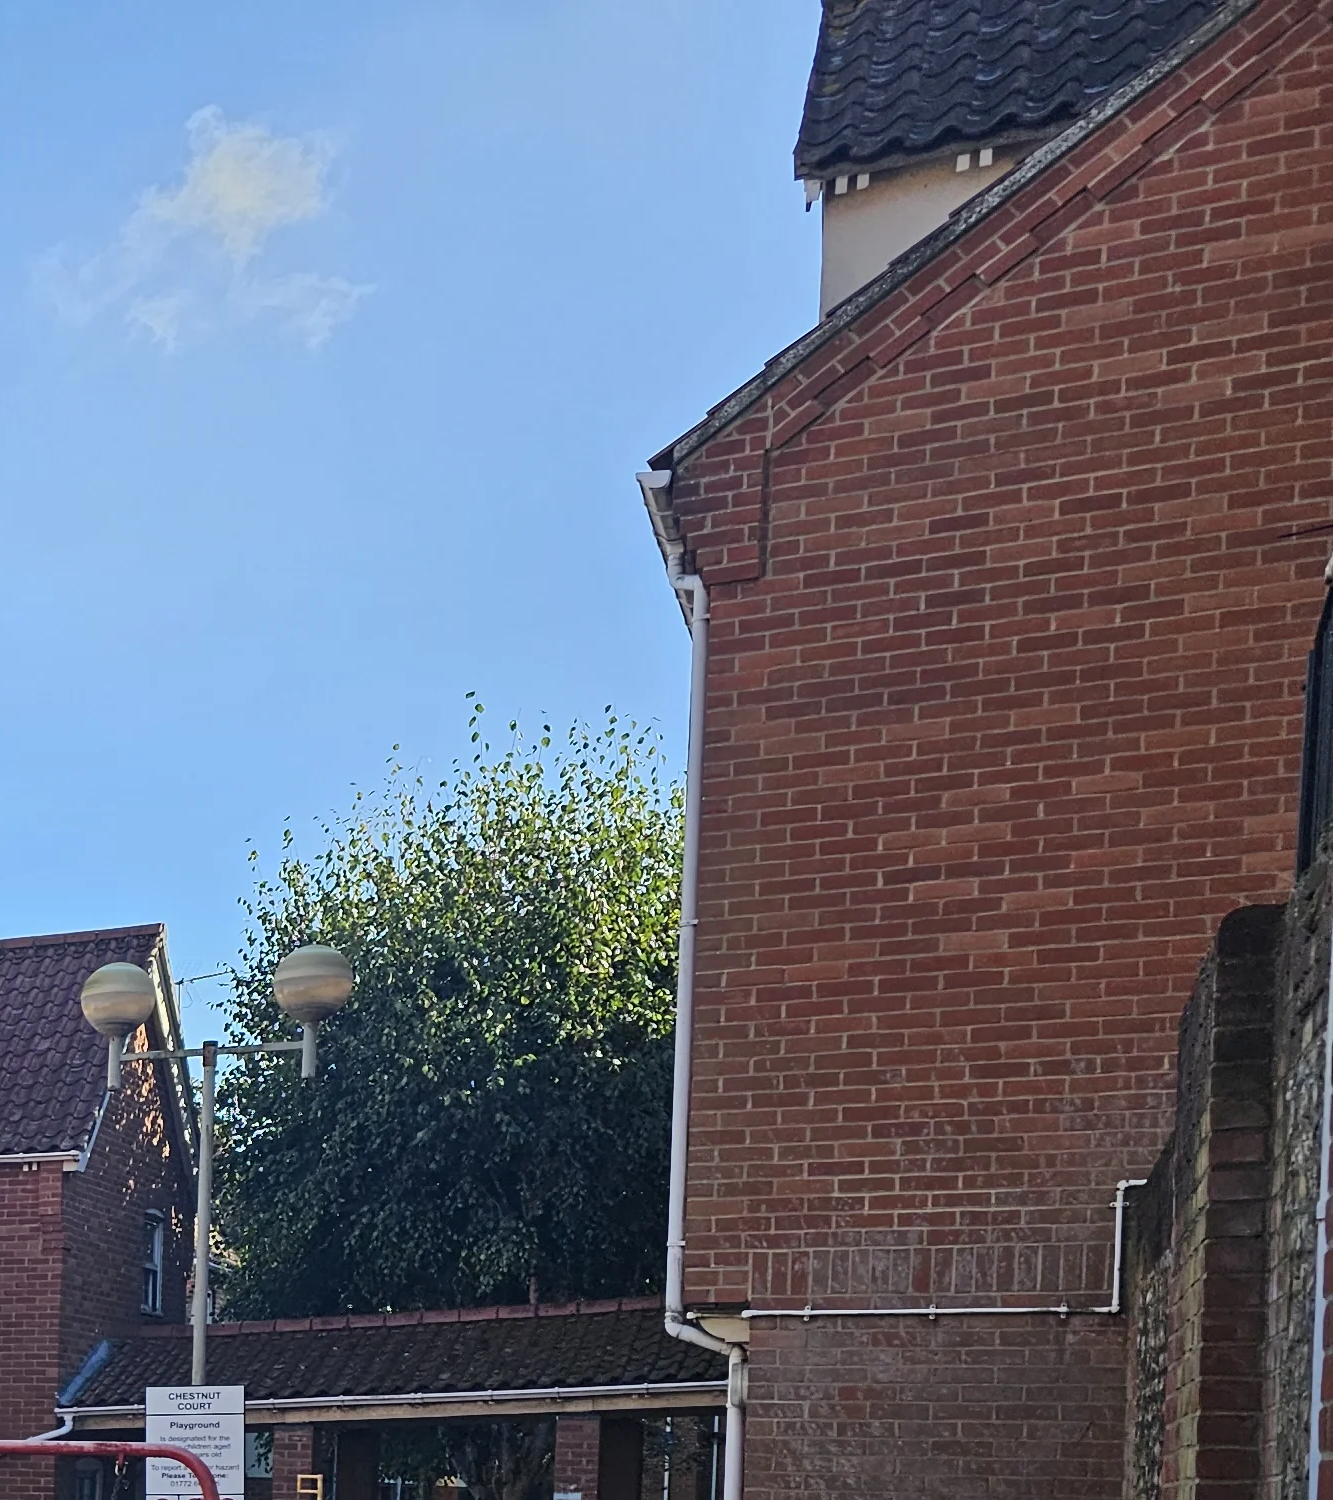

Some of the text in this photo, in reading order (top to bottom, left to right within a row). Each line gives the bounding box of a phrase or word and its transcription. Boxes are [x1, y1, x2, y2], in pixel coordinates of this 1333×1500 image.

[168, 1392, 221, 1400] CHESTNUT
[177, 1402, 213, 1410] COURT
[169, 1421, 221, 1430] Playground
[167, 1435, 206, 1443] designated
